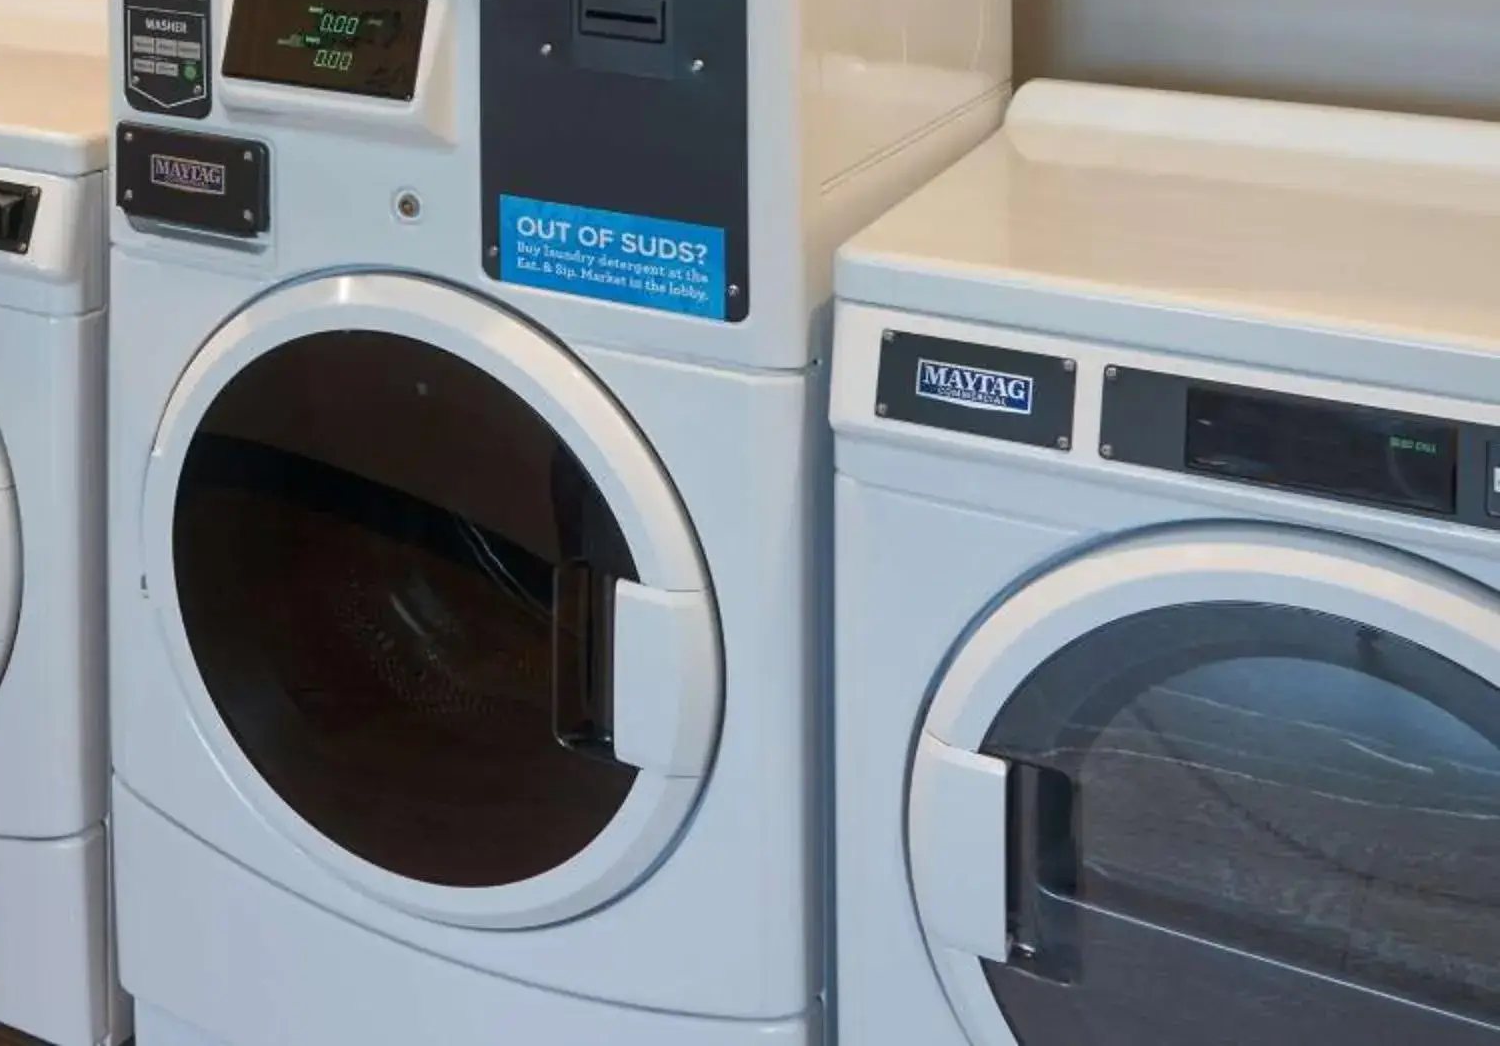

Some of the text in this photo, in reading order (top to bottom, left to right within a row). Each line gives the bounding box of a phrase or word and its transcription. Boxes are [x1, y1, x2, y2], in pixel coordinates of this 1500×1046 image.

[145, 17, 188, 34] WASHER
[155, 158, 221, 184] MAYTAG
[517, 216, 708, 266] OUT OF SUDS?
[517, 241, 540, 257] Buy
[543, 244, 595, 266] laundry
[598, 253, 665, 275] detergent
[686, 267, 708, 283] the
[580, 267, 627, 286] Market
[644, 276, 666, 293] the
[923, 365, 1025, 400] MAYTAG
